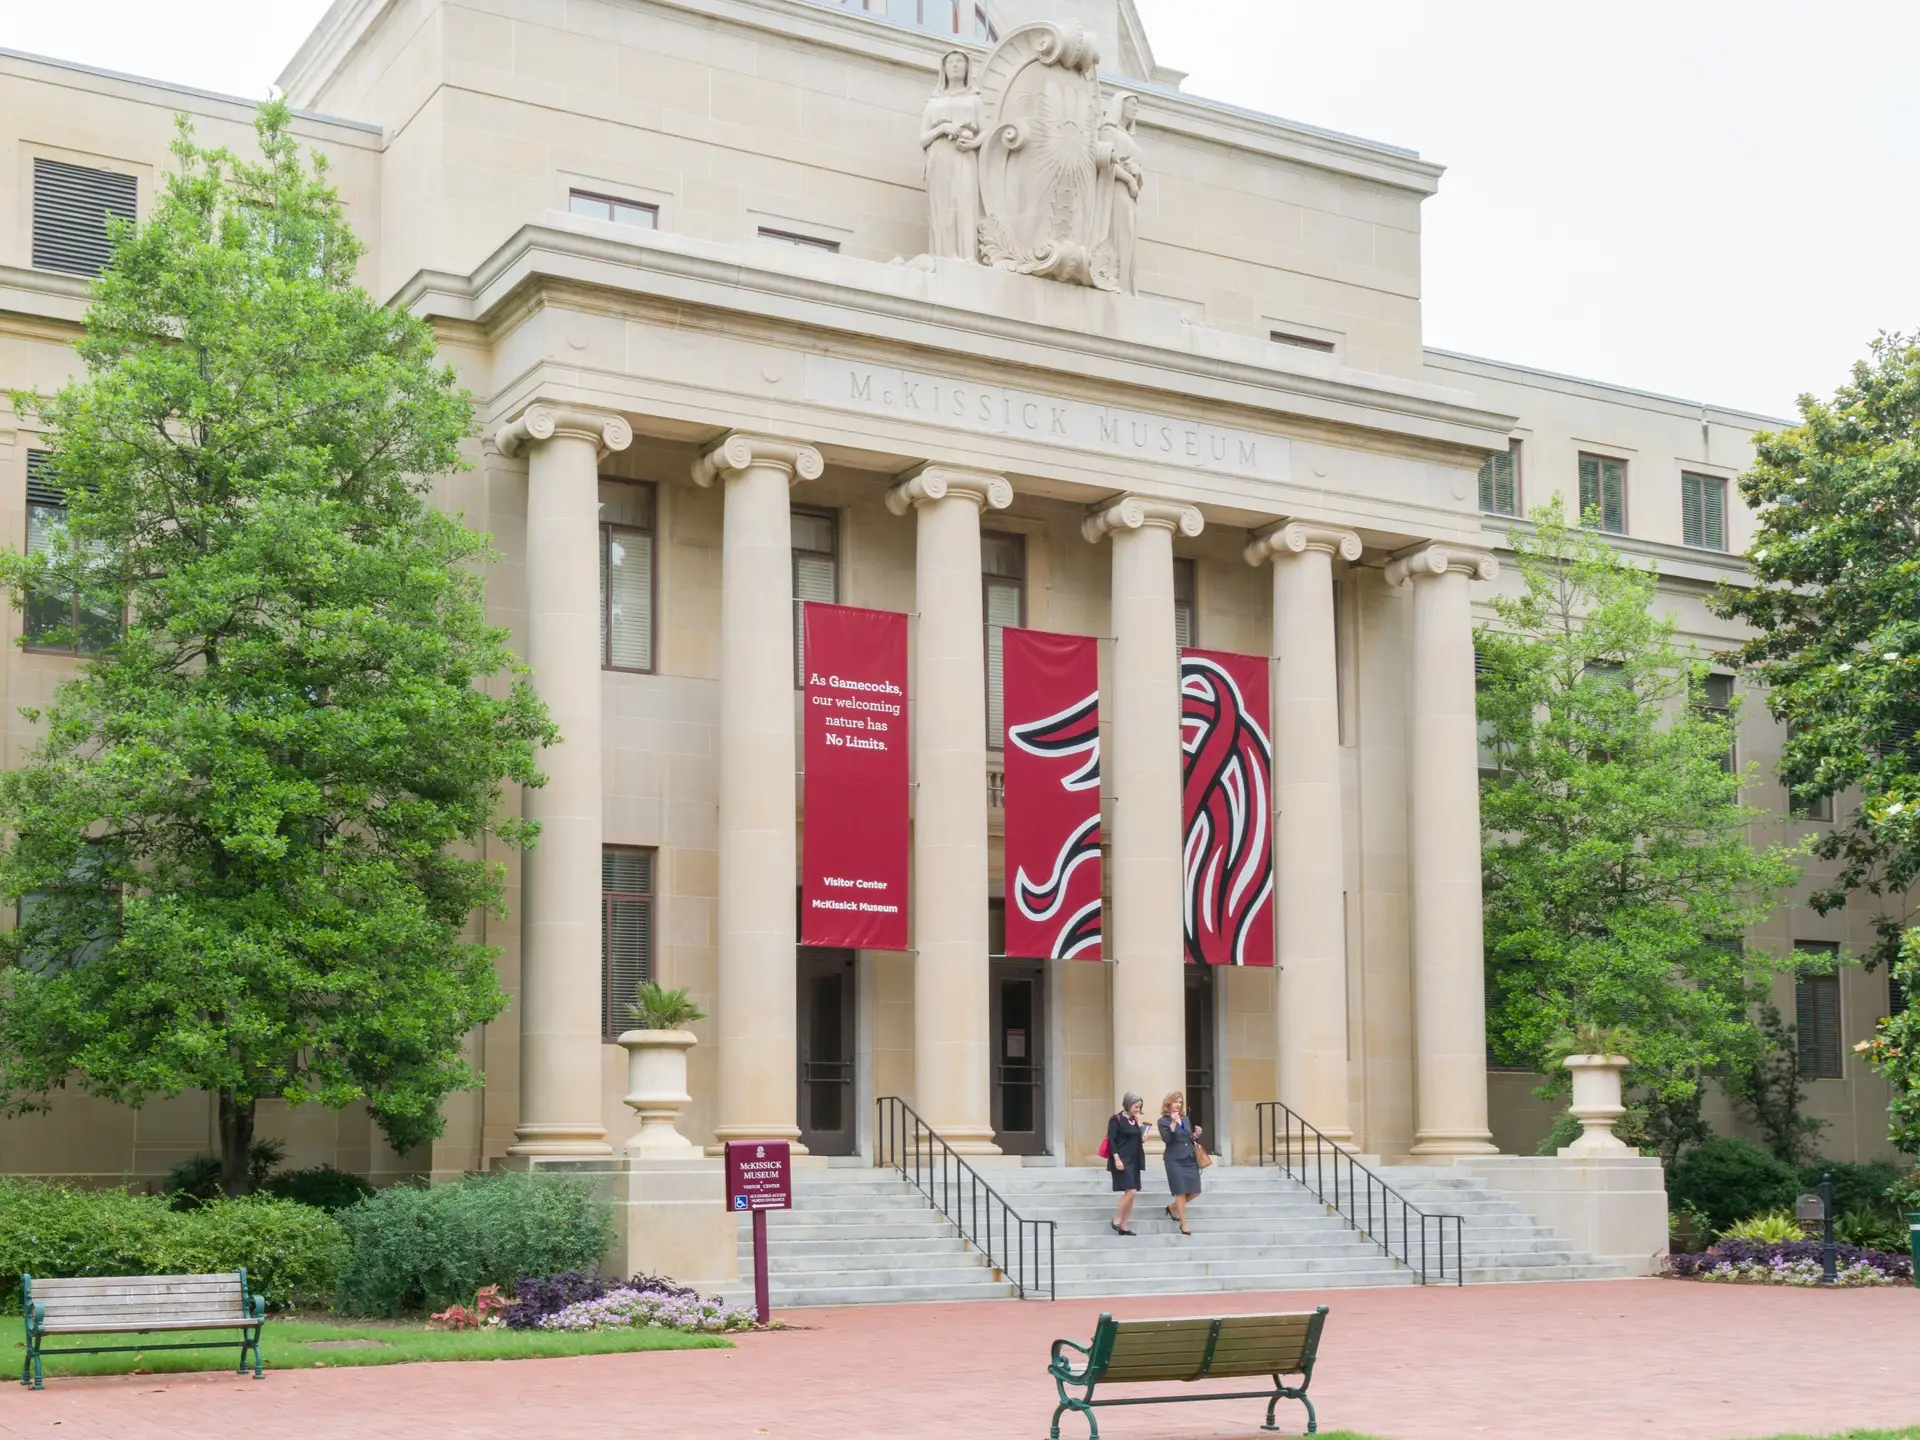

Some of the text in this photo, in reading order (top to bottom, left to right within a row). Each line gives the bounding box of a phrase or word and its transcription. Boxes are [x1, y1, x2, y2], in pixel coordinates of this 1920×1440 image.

[849, 371, 1258, 468] McKISSICK MUSEUM
[810, 673, 902, 696] As Gamecocks,
[812, 696, 900, 716] our welcoming
[825, 717, 888, 731] nature has
[825, 733, 888, 751] No Limits.
[823, 876, 888, 890] Visitor Center
[812, 899, 898, 914] McKissick Museum
[740, 1161, 782, 1170] McKISSICK
[743, 1171, 779, 1179] MUSEUM
